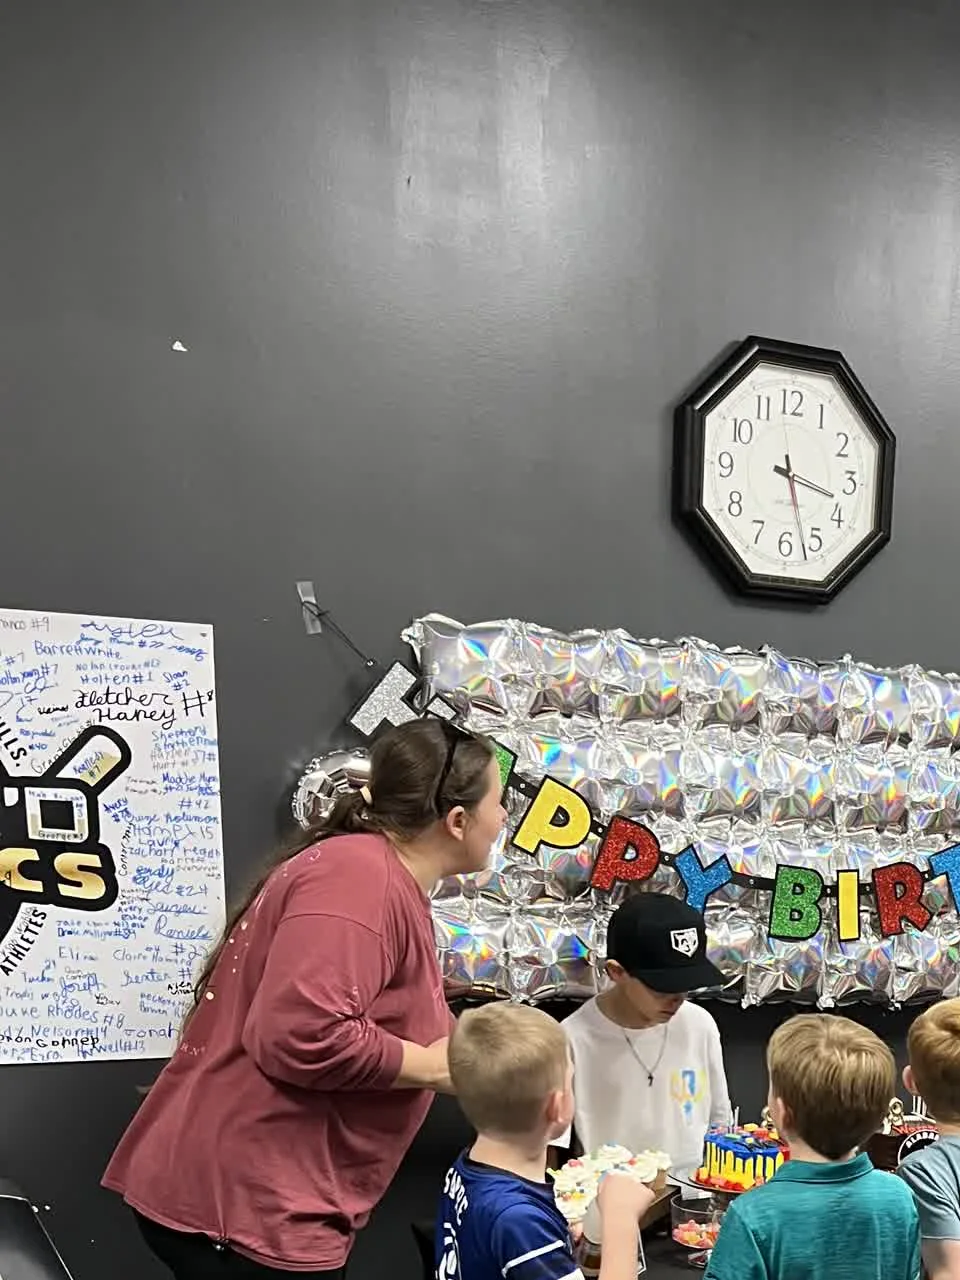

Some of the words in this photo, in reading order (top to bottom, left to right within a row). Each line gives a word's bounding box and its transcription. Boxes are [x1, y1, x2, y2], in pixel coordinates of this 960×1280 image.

[756, 394, 771, 421] 11
[781, 389, 804, 417] 12
[818, 404, 824, 430] 1
[732, 418, 753, 444] 10
[835, 432, 849, 458] 2
[718, 451, 734, 478] 9
[842, 470, 857, 495] 3
[727, 491, 742, 517] 8
[830, 502, 844, 529] 4
[752, 519, 765, 545] 7
[778, 531, 793, 557] 6
[808, 527, 823, 552] 5
[0, 909, 47, 977] ATHLETES
